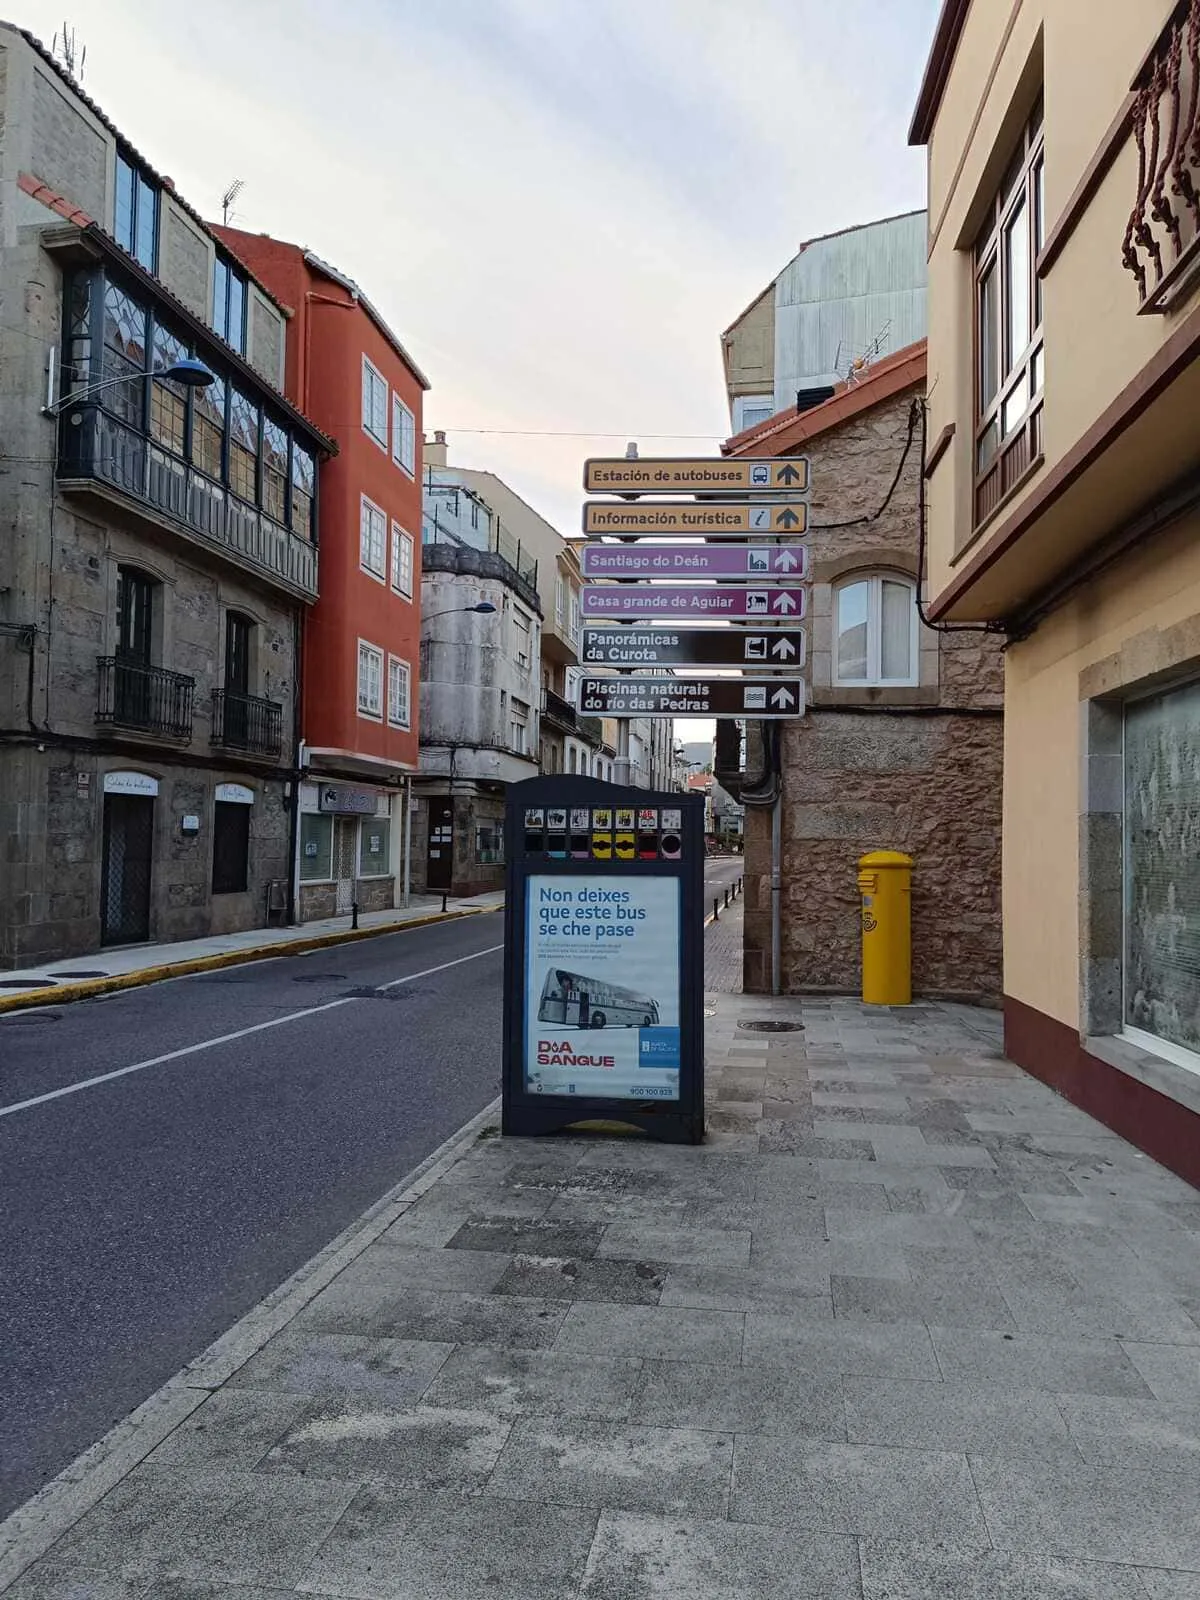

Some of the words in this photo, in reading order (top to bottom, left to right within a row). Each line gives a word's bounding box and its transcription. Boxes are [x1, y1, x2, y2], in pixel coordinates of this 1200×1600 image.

[593, 469, 650, 481] Estación
[654, 470, 670, 481] de
[674, 470, 742, 481] autobuses
[592, 511, 677, 524] Información
[681, 512, 742, 524] turística
[590, 555, 650, 569] Santiago
[653, 555, 669, 566] do
[674, 555, 708, 566] Deán
[588, 595, 620, 607] Casa
[623, 596, 668, 610] grande
[671, 596, 687, 607] de
[690, 596, 735, 610] Aguiar
[588, 632, 679, 646] Panorámicas
[586, 648, 604, 660] da
[608, 648, 657, 660] Curota
[586, 682, 646, 695] Piscinas
[650, 682, 710, 695] naturais
[585, 697, 603, 709] do
[606, 697, 625, 709] río
[629, 697, 654, 710] das
[660, 699, 710, 711] Pedras
[540, 888, 573, 902] Non
[578, 888, 630, 903] deixes
[539, 908, 570, 922] que
[575, 906, 612, 919] este
[616, 905, 646, 920] bus
[539, 924, 558, 936] se
[562, 922, 591, 936] che
[596, 924, 635, 940] pase
[537, 1054, 616, 1067] SANGUE
